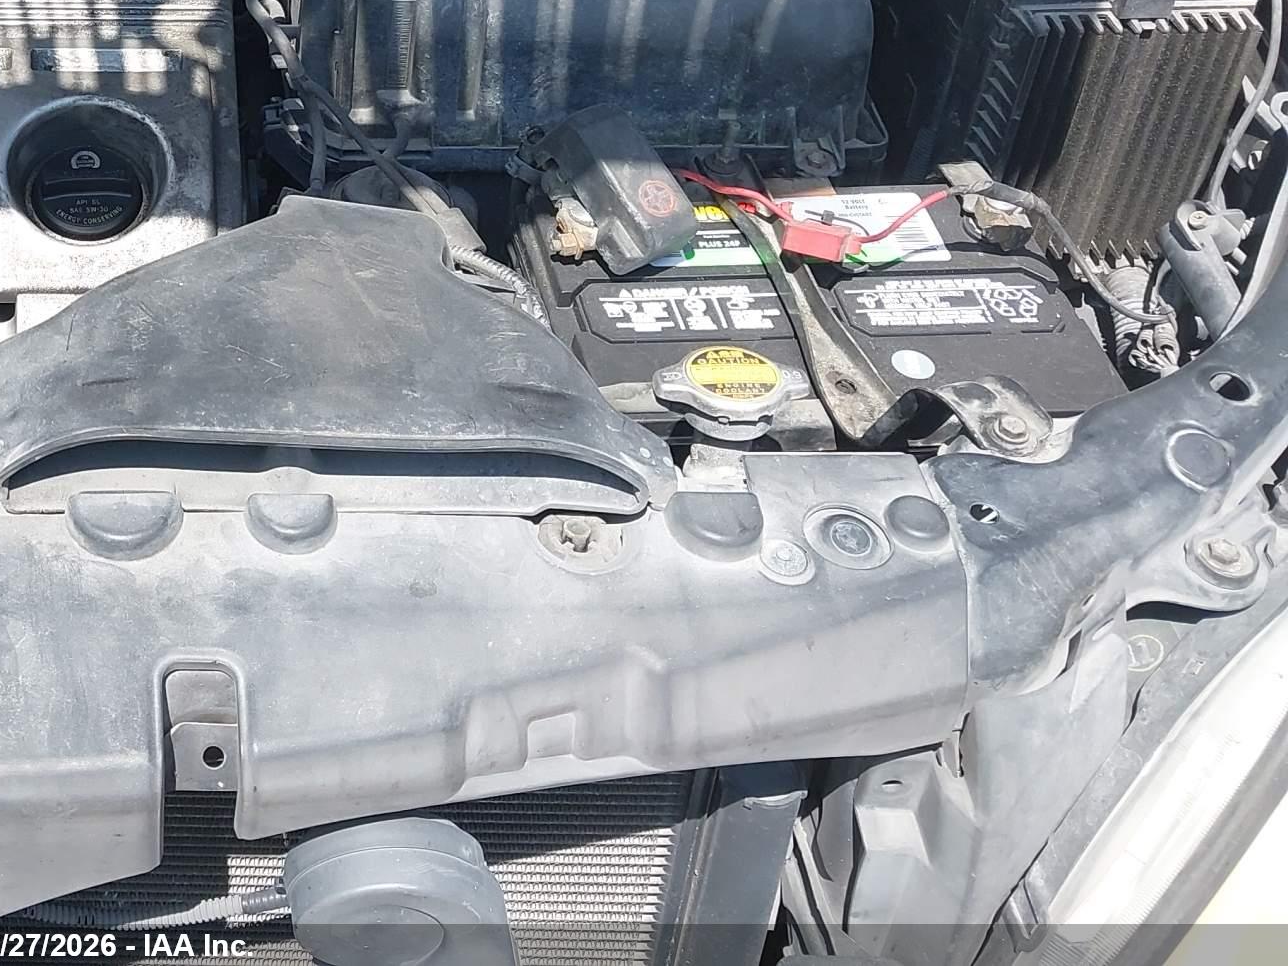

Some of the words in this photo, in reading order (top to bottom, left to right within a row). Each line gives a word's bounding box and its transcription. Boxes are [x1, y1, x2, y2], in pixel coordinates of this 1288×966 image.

[56, 209, 81, 223] ENERGY
[83, 206, 123, 225] CONSERVING
[782, 369, 802, 379] 0.9
